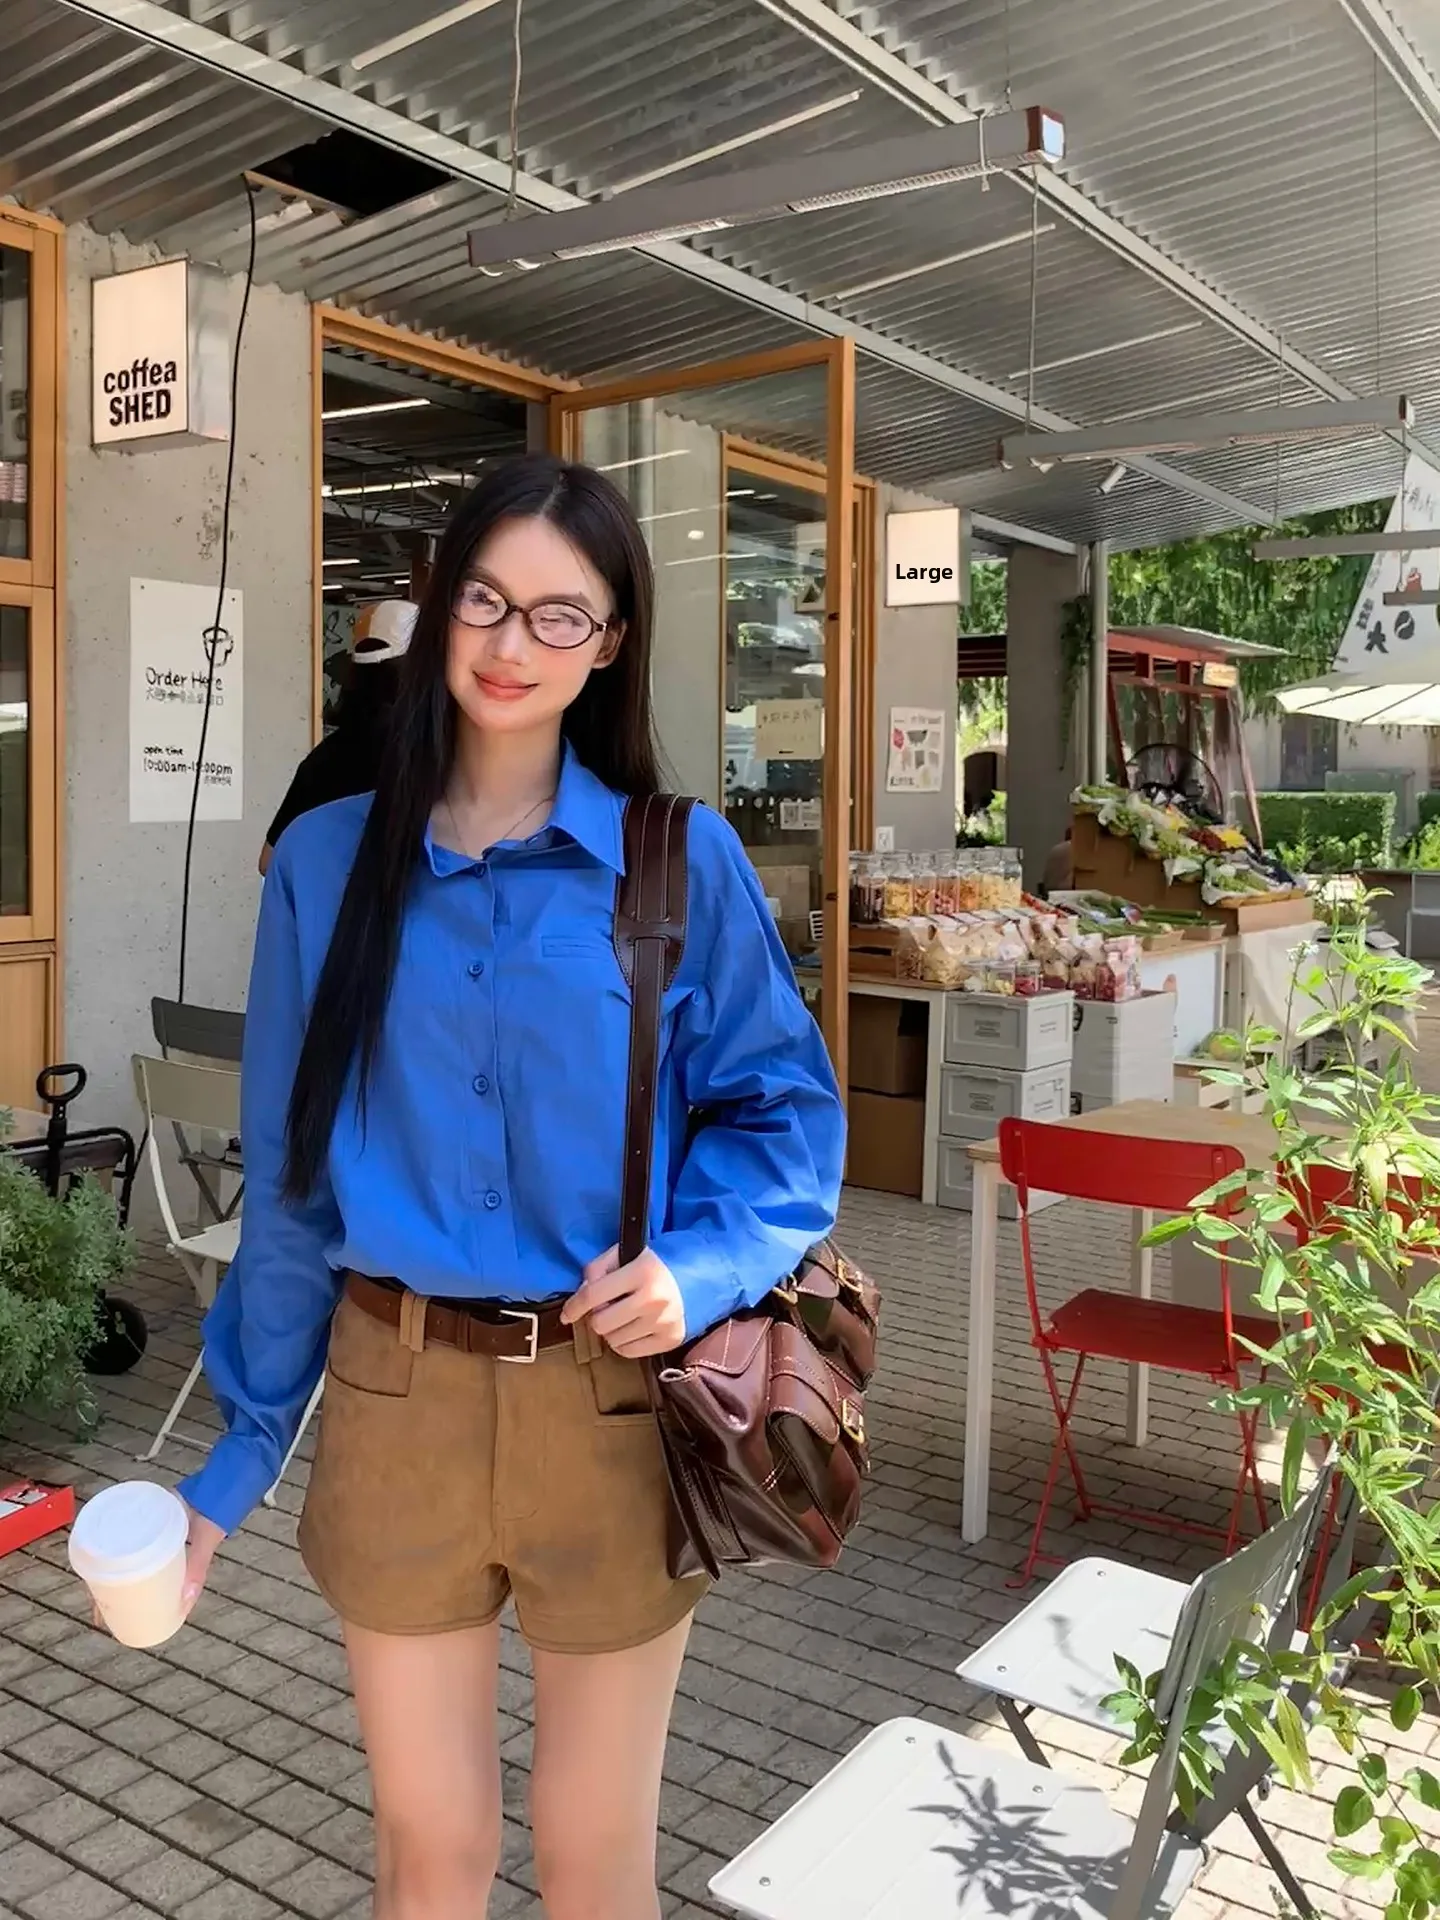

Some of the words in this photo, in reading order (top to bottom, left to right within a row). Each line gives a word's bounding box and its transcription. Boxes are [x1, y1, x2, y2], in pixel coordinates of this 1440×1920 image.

[104, 358, 177, 394] coffea
[109, 389, 171, 427] SHED
[896, 563, 953, 583] Large
[145, 667, 187, 687] Order
[191, 670, 223, 691] Hee
